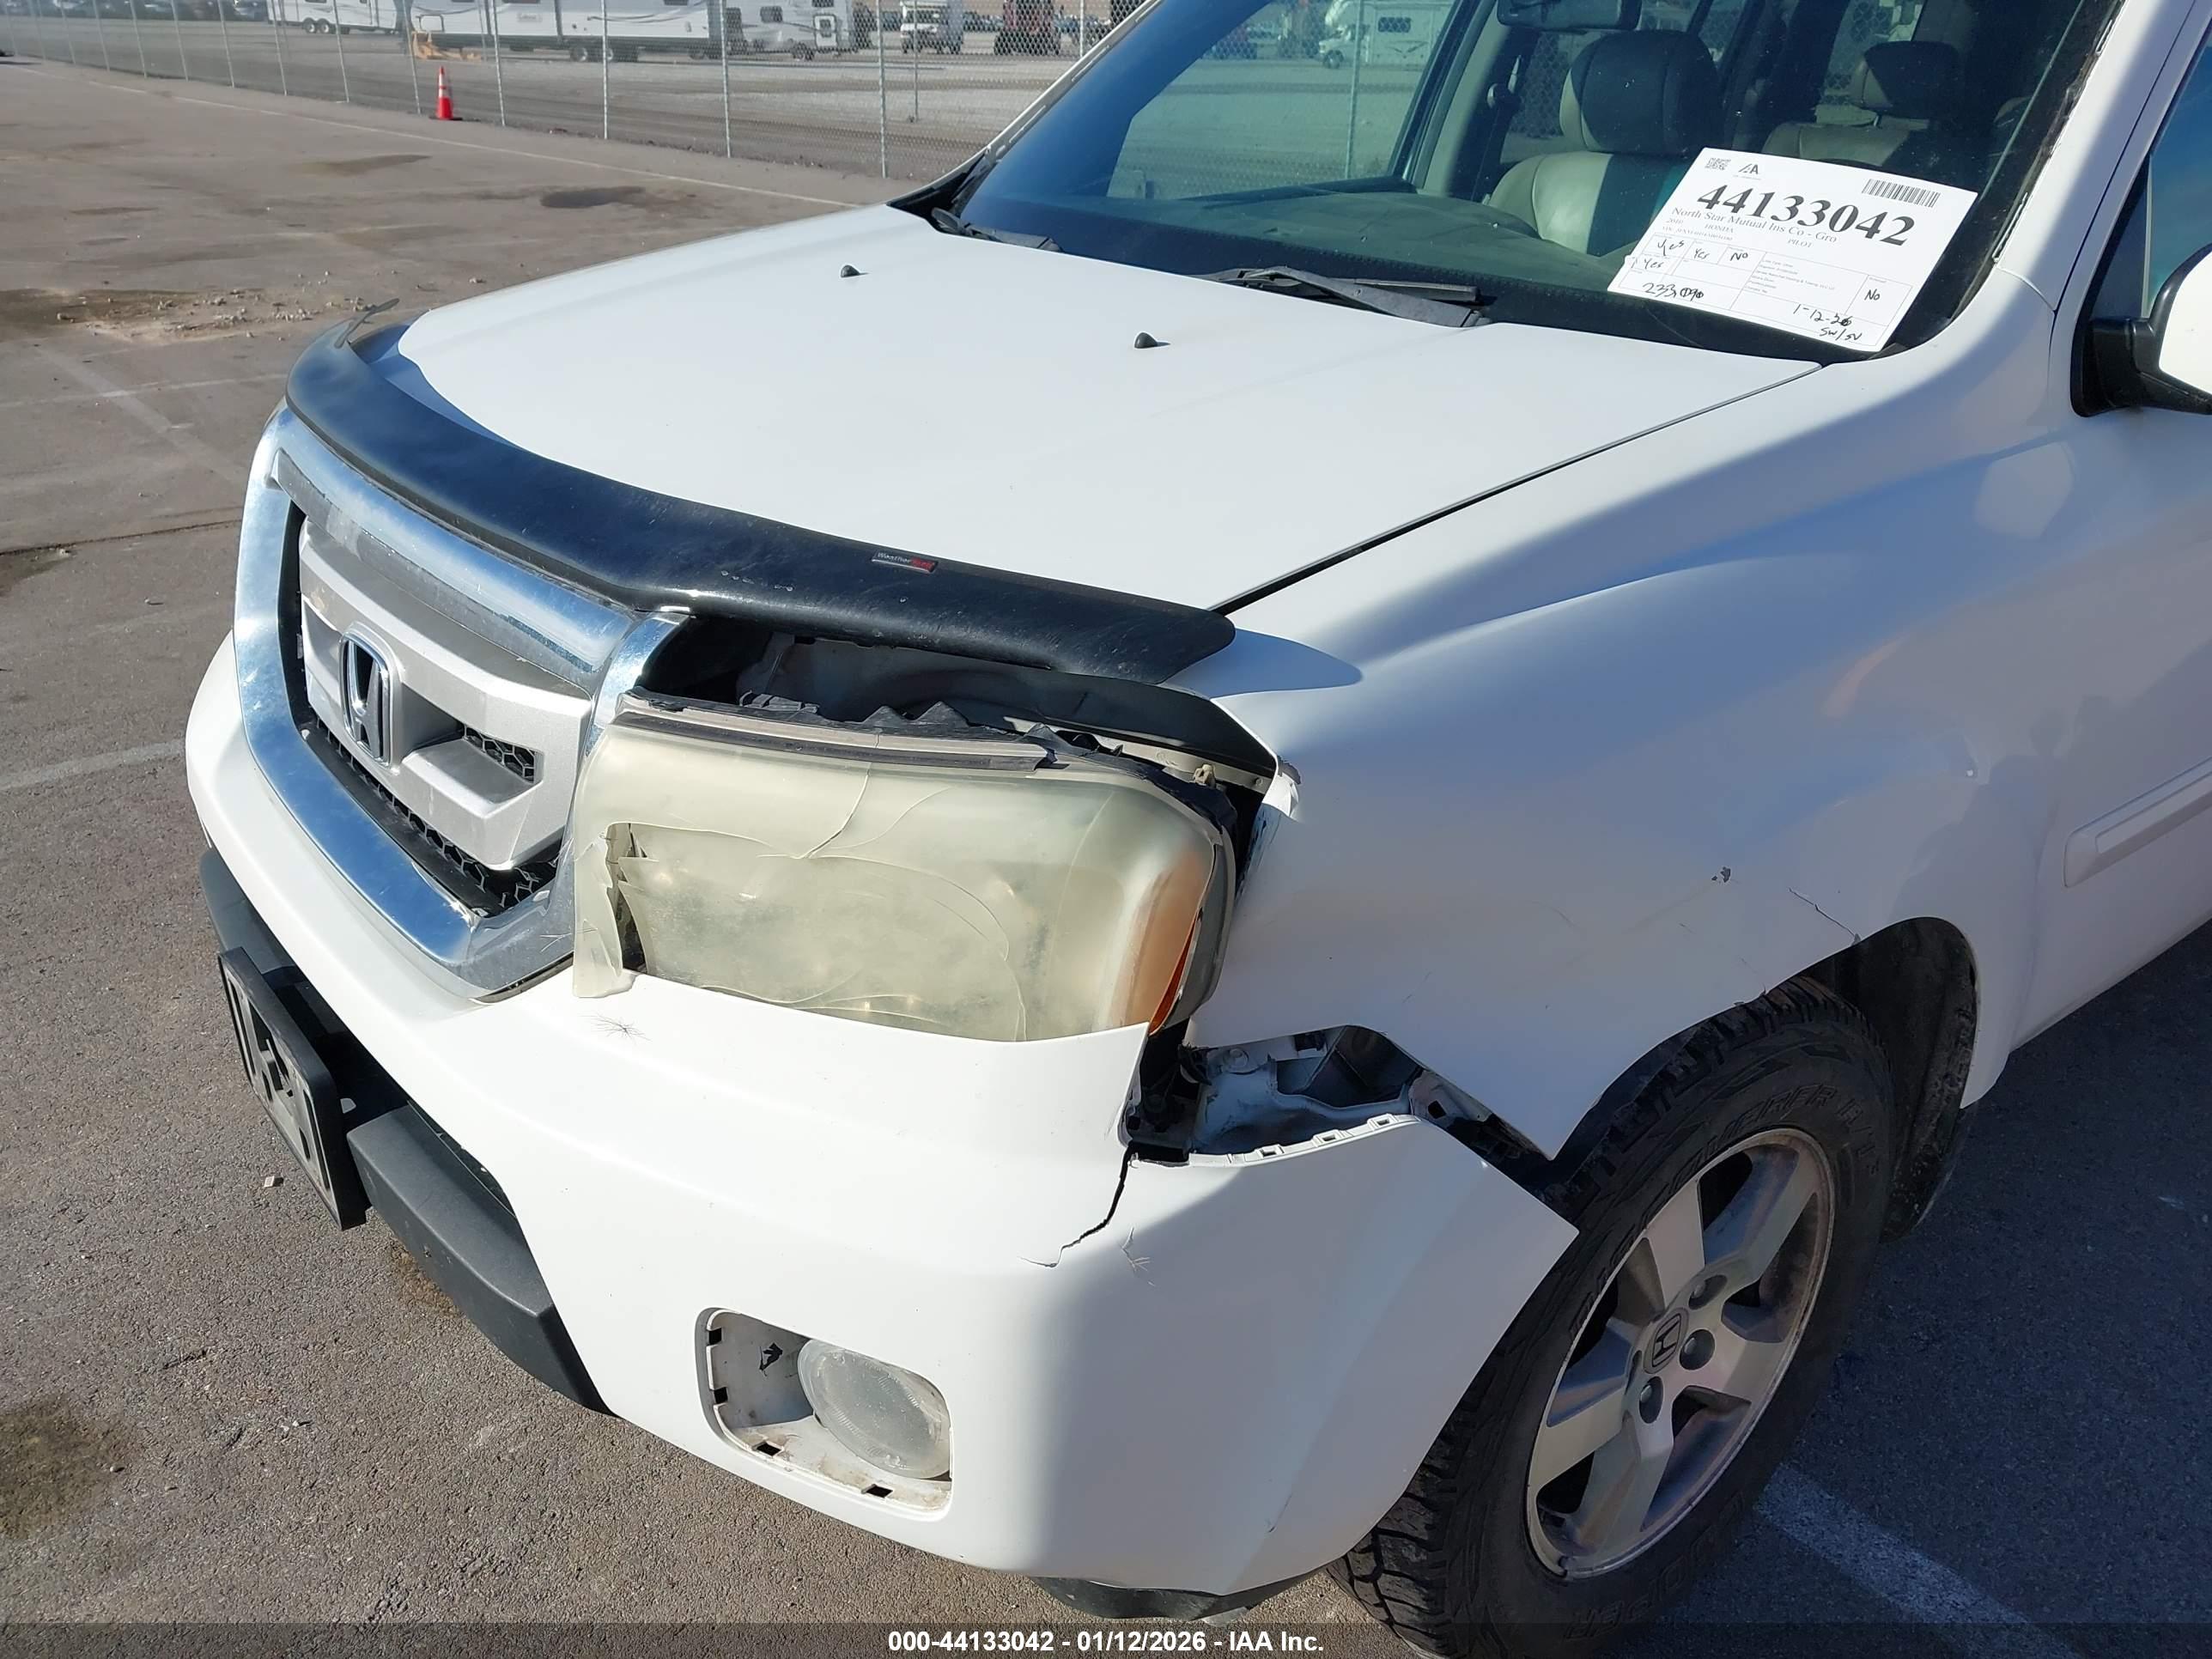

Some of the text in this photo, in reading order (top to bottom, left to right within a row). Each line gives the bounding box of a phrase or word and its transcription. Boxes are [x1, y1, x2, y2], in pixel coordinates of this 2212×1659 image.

[1671, 206, 1702, 219] North
[1704, 211, 1726, 222] Star
[1728, 215, 1767, 229] Mutual
[1768, 222, 1786, 233] Ins
[1788, 226, 1805, 236] Co
[1815, 231, 1838, 243] Gro
[1697, 184, 1916, 246] 44133042
